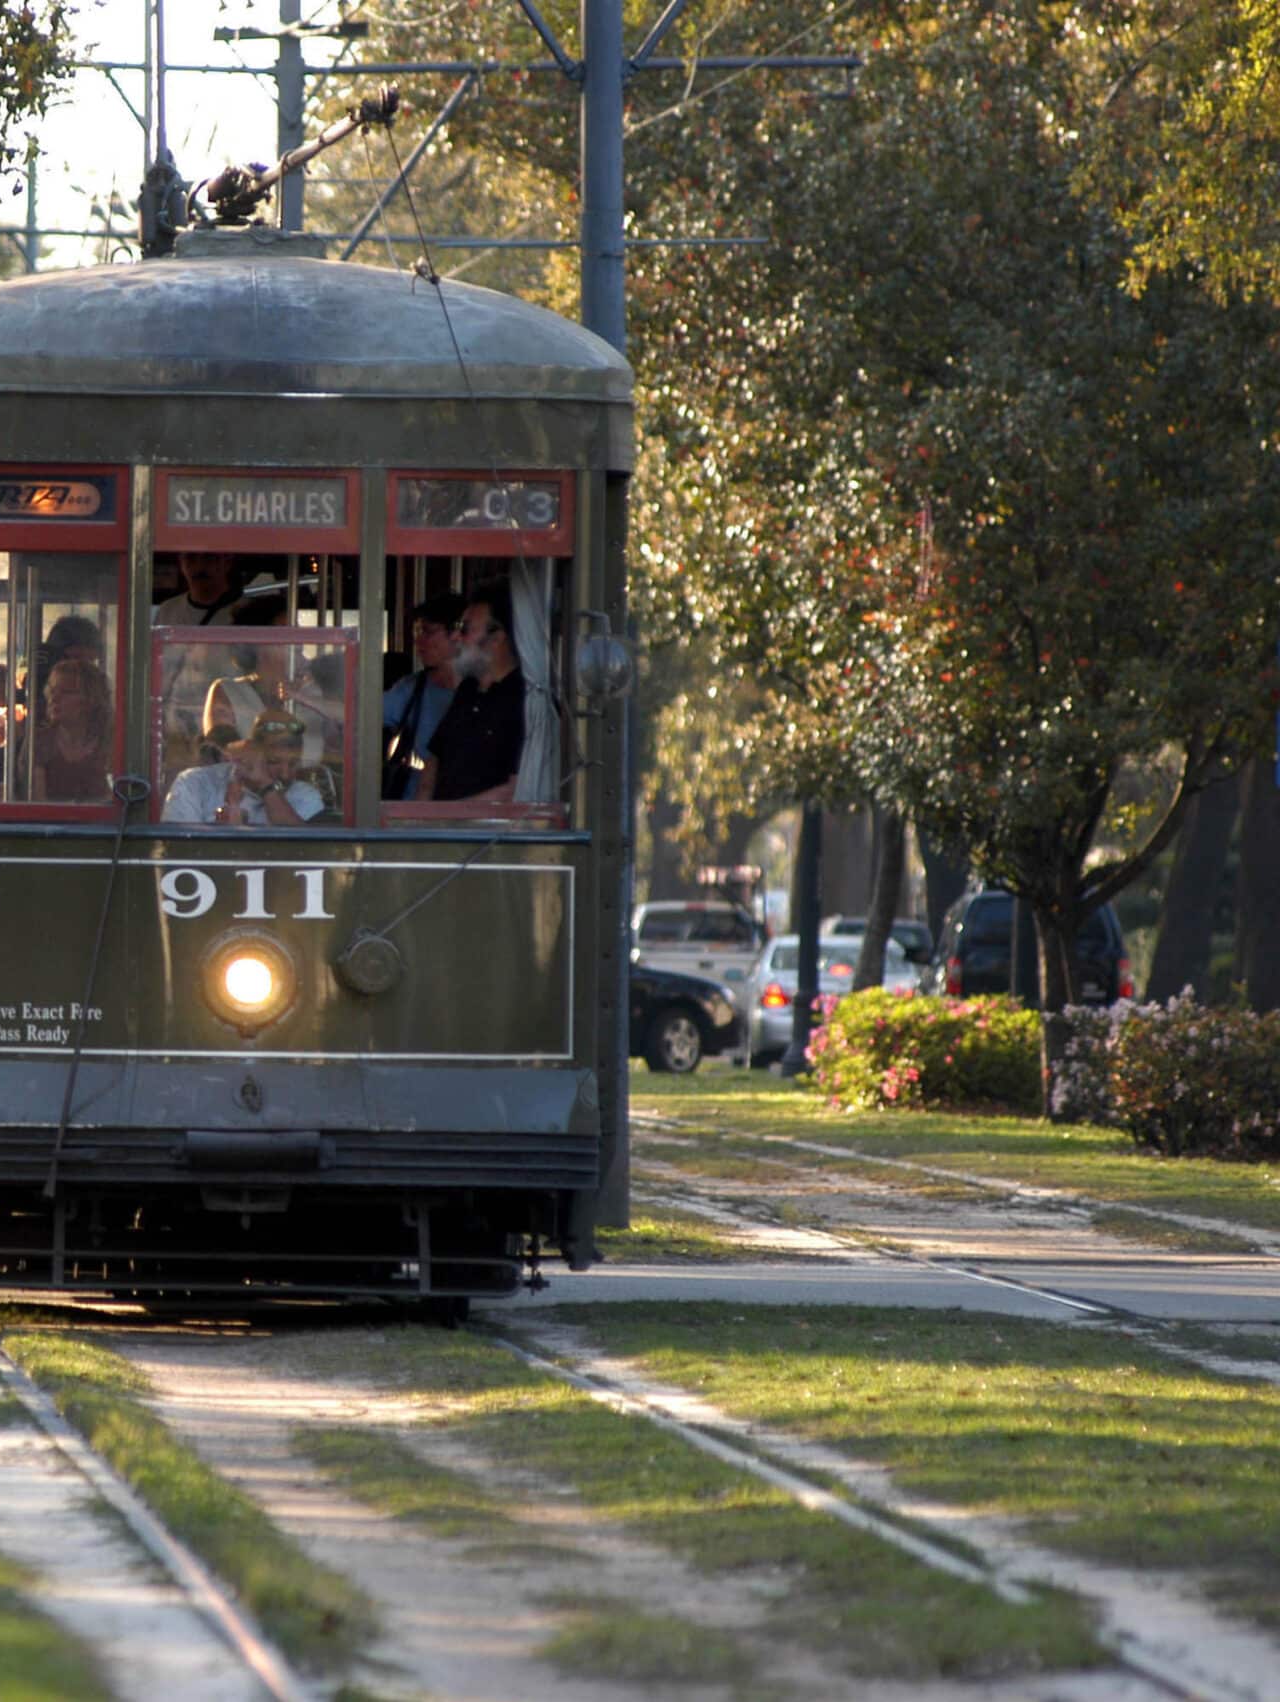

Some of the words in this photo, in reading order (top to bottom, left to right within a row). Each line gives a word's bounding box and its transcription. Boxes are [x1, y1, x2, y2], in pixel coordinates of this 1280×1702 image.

[175, 490, 210, 522] ST.
[217, 490, 336, 524] CHARLES
[160, 868, 336, 919] 911
[22, 1003, 63, 1020] Exact
[27, 1024, 69, 1044] Ready
